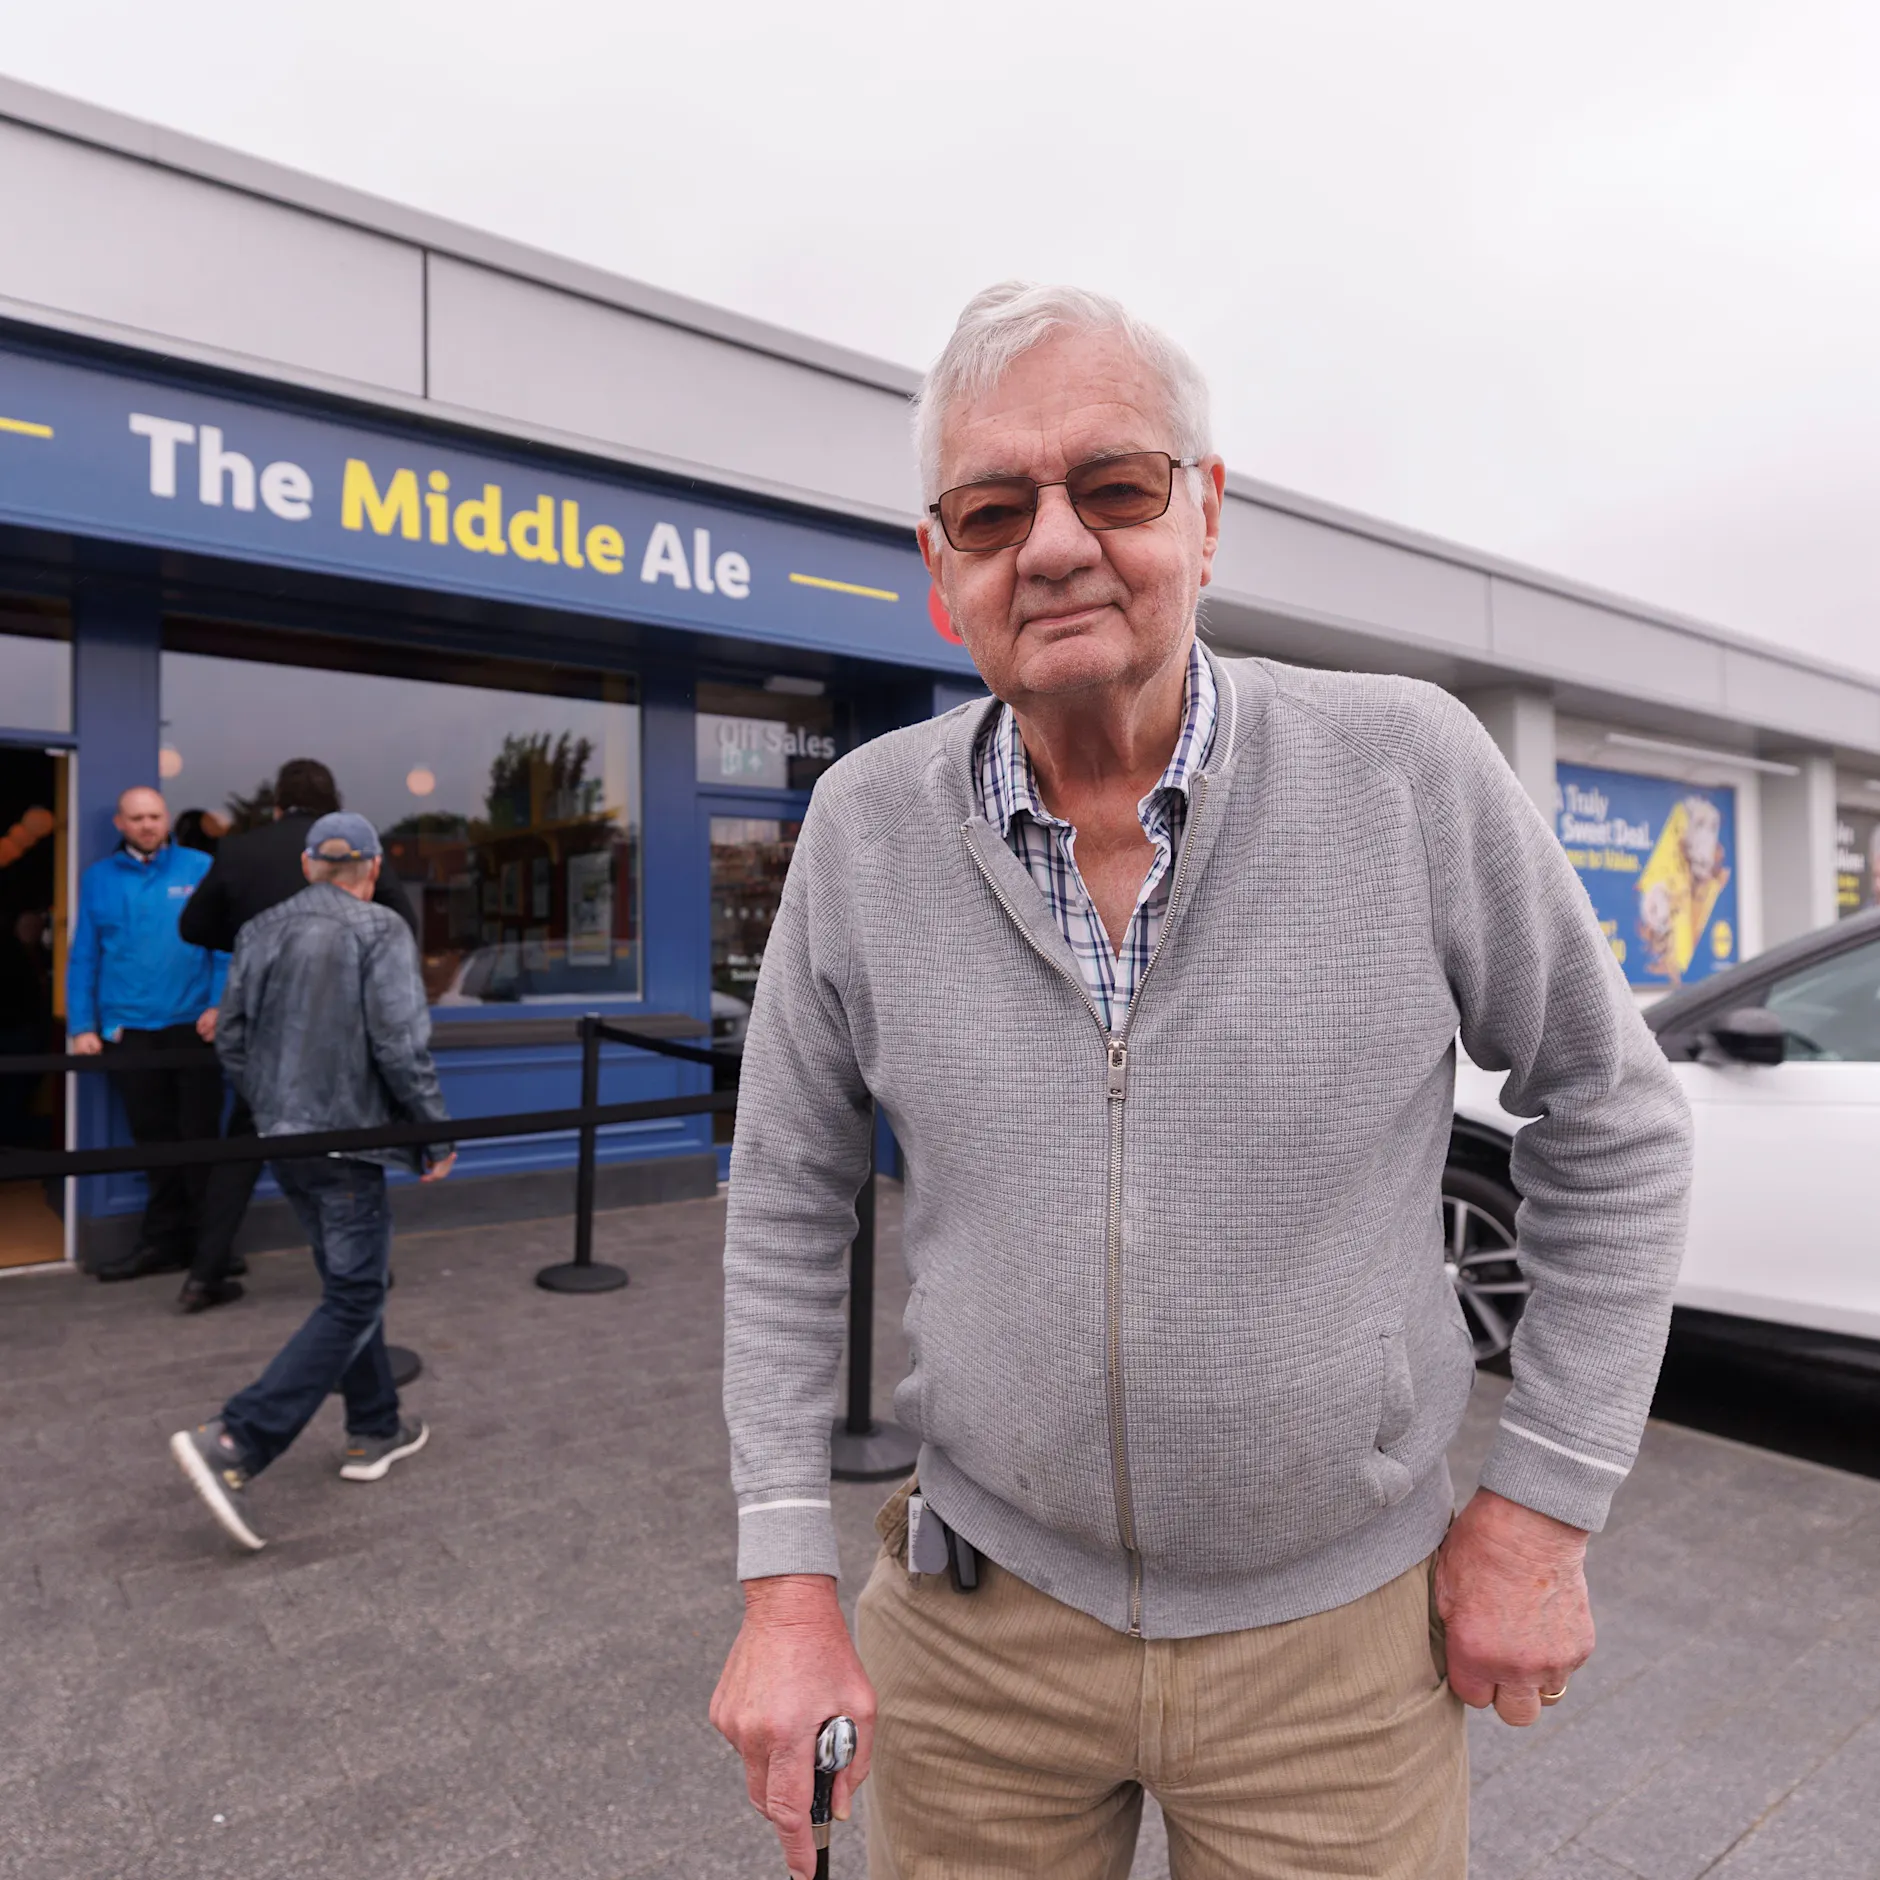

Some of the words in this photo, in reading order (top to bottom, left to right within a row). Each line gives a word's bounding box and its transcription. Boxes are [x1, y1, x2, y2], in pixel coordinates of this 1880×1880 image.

[128, 413, 313, 521] The
[341, 458, 625, 574] Middle
[640, 522, 750, 599] Ale
[762, 722, 836, 760] Sales
[1565, 784, 1609, 822] Truly
